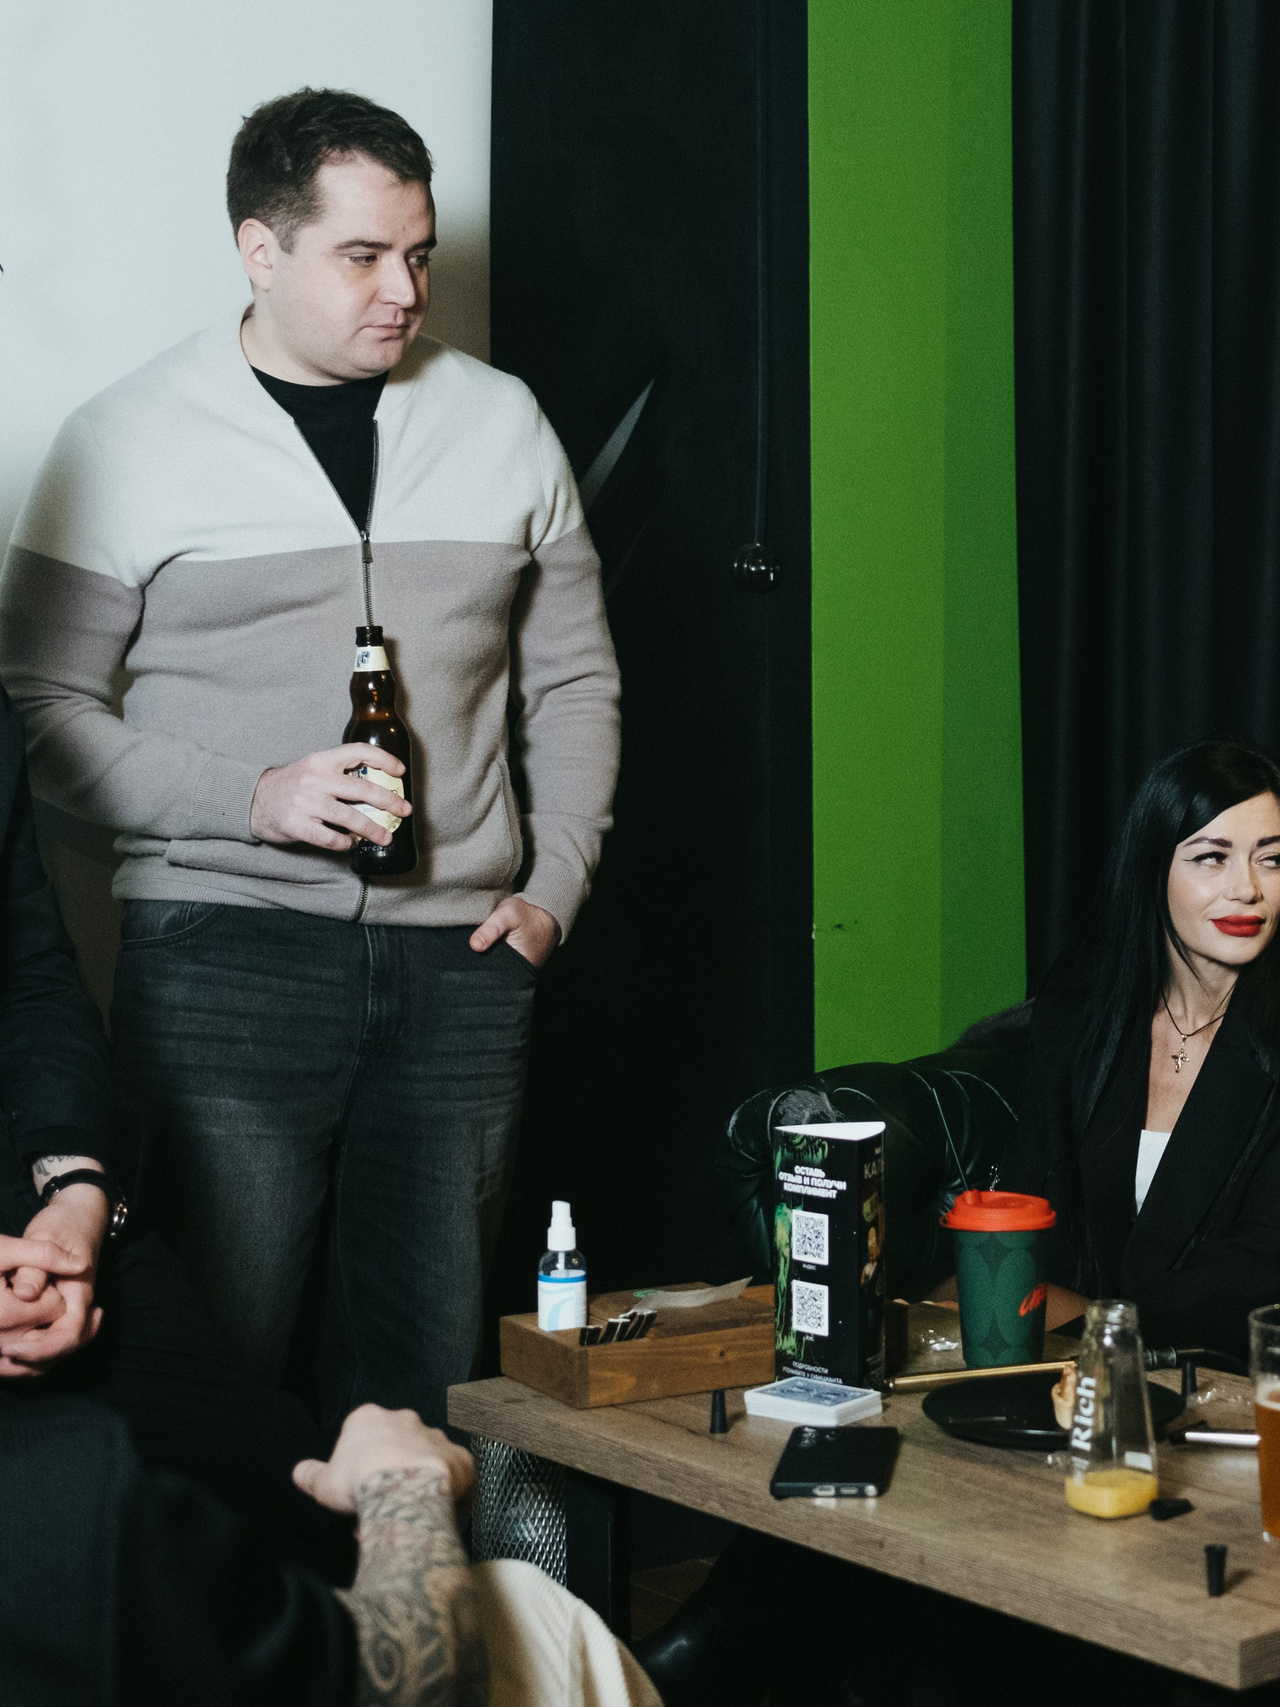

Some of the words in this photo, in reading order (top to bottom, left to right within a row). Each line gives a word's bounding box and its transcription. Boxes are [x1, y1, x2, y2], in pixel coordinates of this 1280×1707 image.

[794, 1165, 826, 1179] ОСТАВЬ
[783, 1181, 838, 1199] КОМПЛИМЕНТ
[803, 1176, 810, 1185] И
[810, 1177, 847, 1190] ПОЛУЧИ
